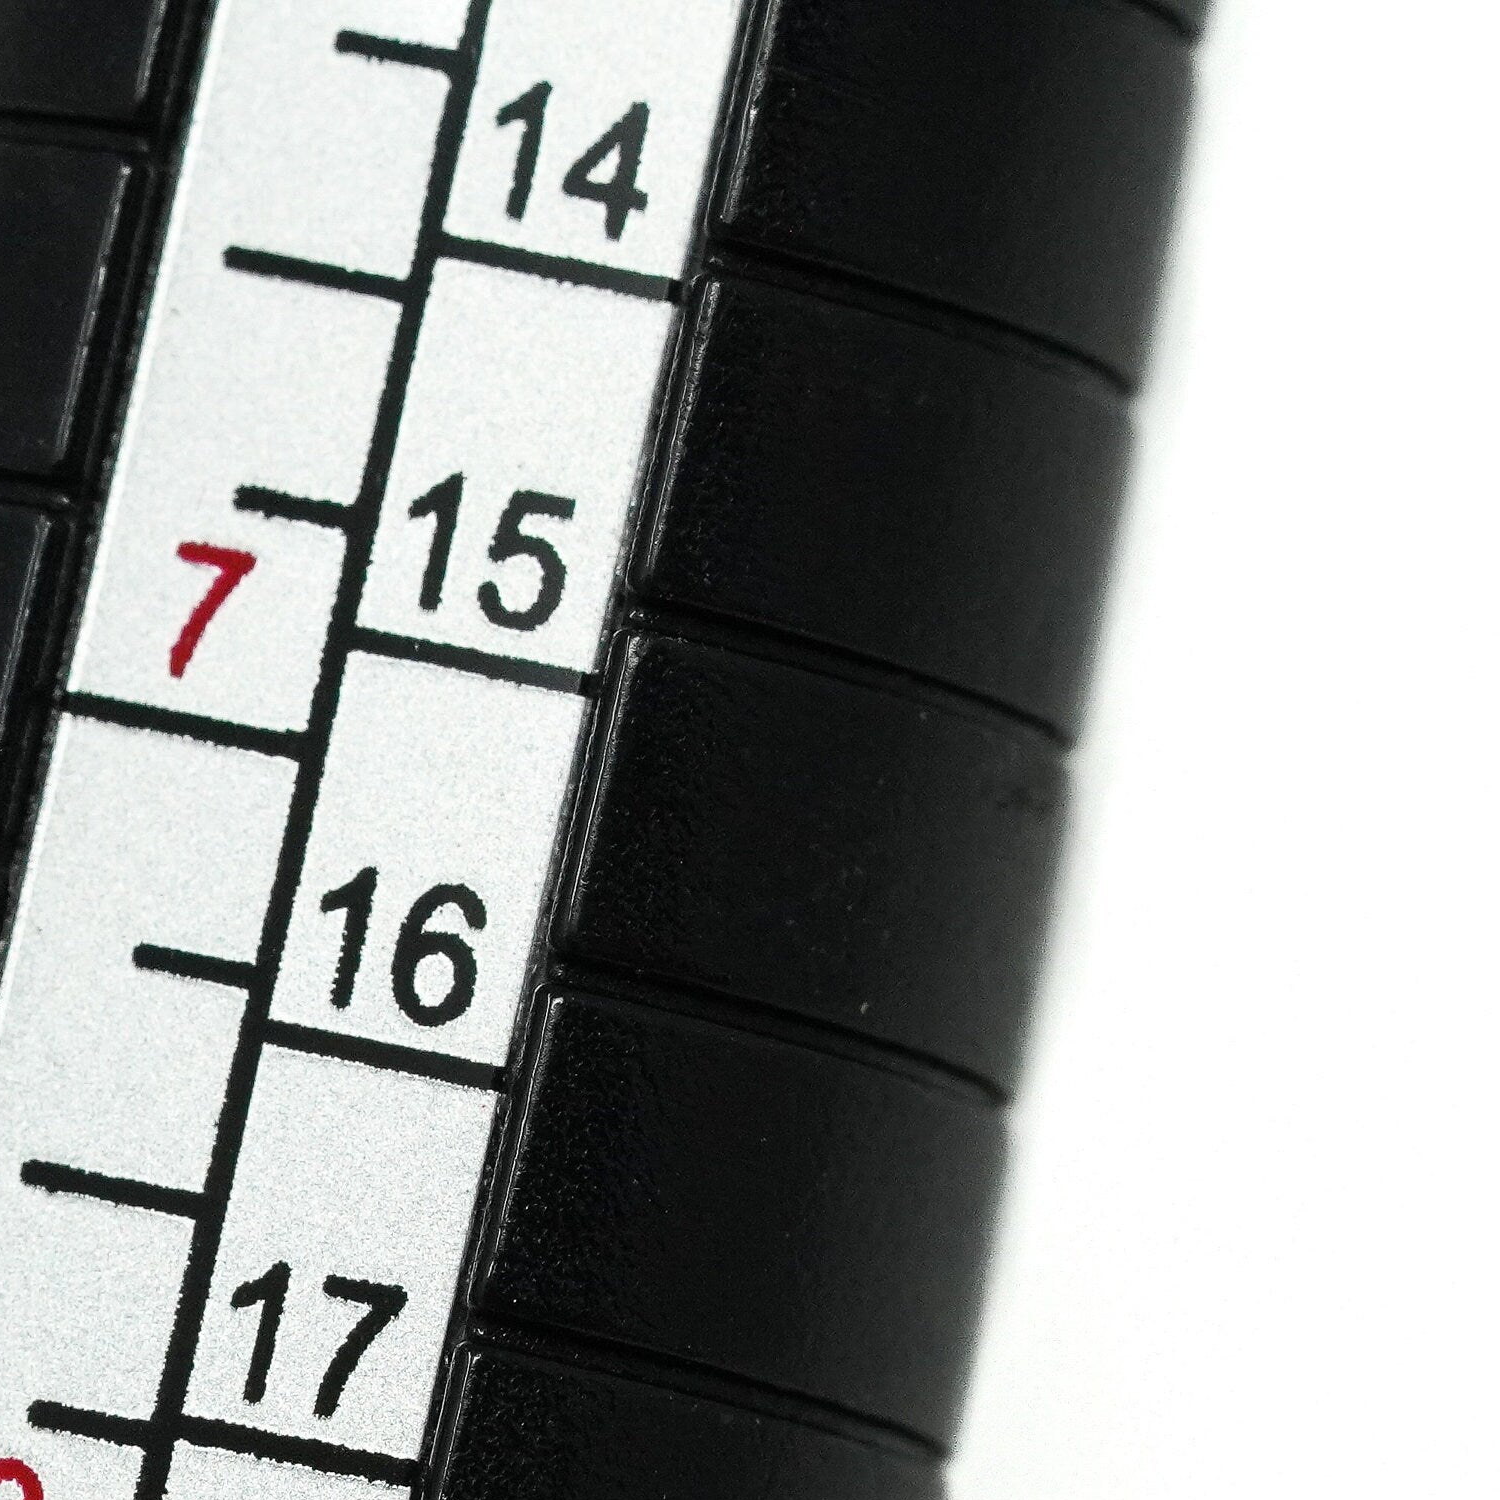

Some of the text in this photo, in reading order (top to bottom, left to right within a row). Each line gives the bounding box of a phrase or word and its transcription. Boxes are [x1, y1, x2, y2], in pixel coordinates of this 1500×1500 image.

[496, 82, 650, 240] 14
[168, 541, 256, 678] 7
[408, 472, 576, 631] 15
[320, 867, 487, 1027] 16
[230, 1261, 409, 1419] 17
